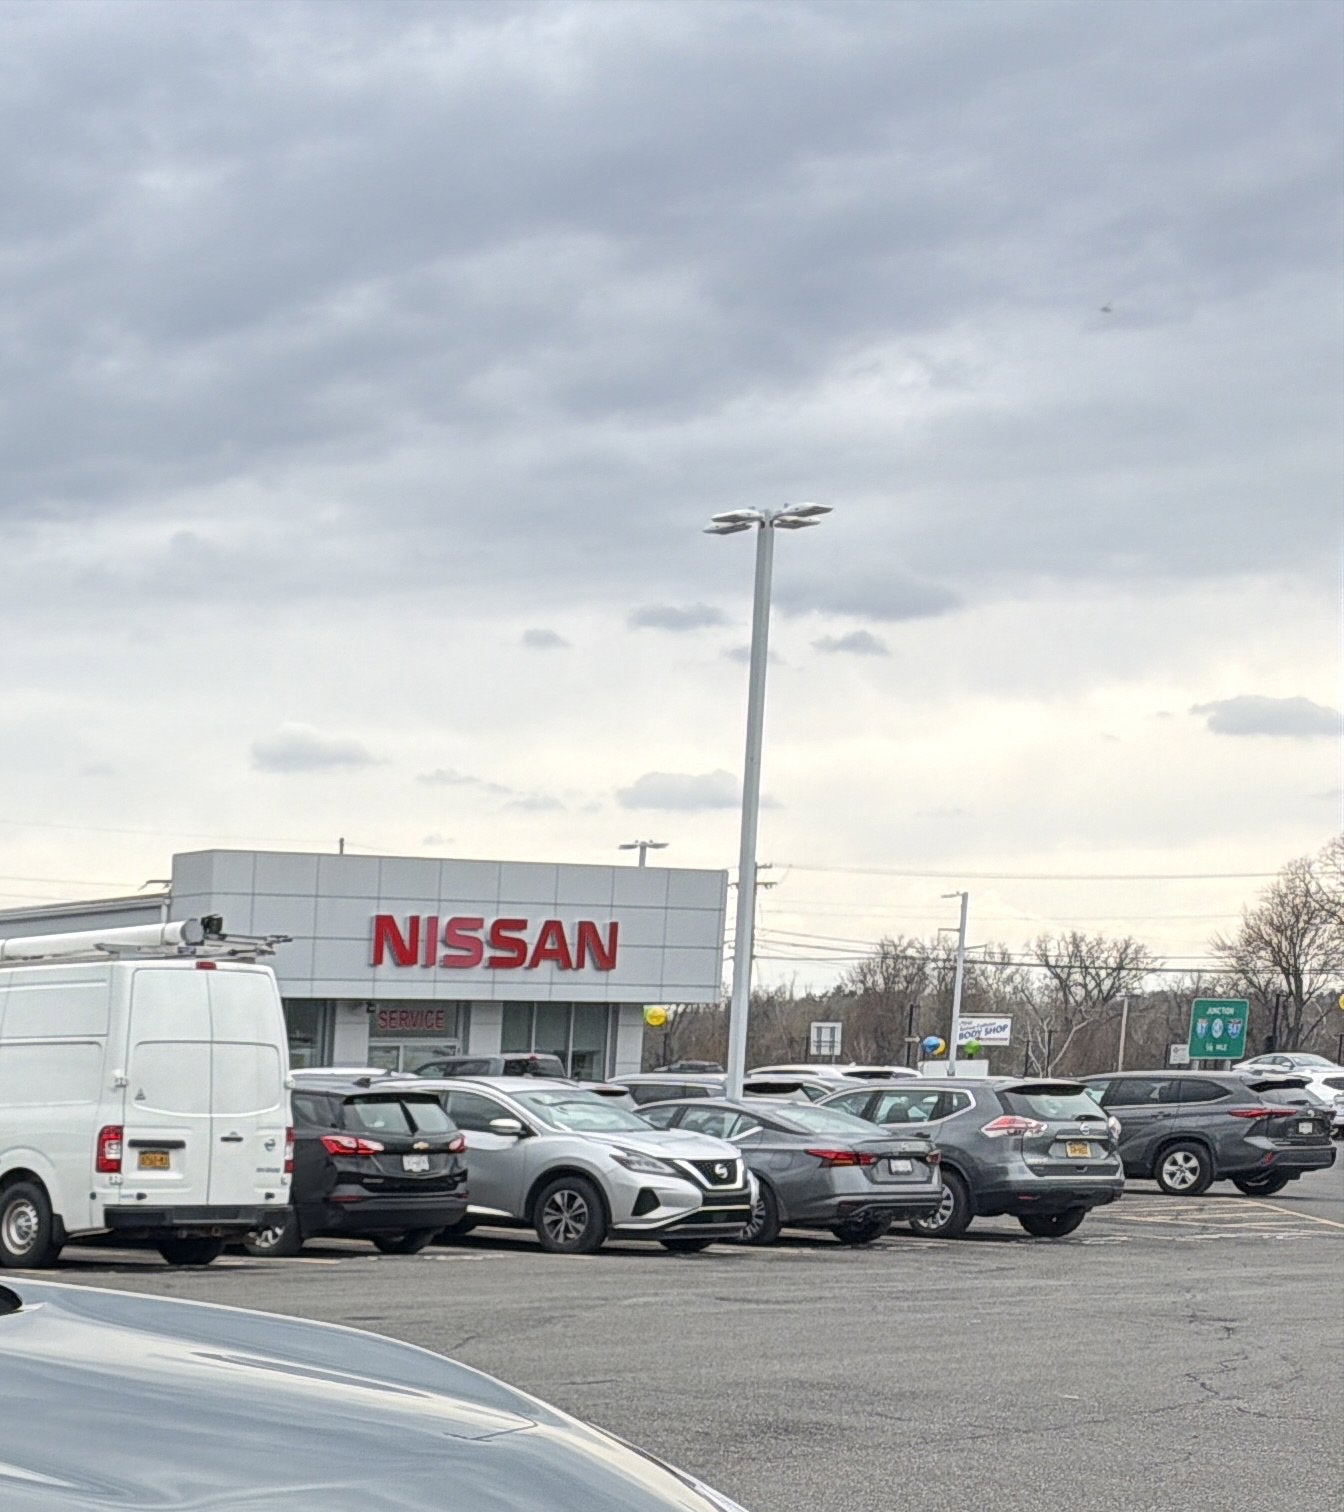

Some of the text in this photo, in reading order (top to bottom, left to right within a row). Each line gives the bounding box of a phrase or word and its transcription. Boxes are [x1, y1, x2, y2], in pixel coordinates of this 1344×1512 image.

[372, 914, 619, 971] NISSAN
[377, 1009, 446, 1030] SERVICE
[958, 1028, 982, 1040] BODY
[985, 1023, 1009, 1036] SHOP
